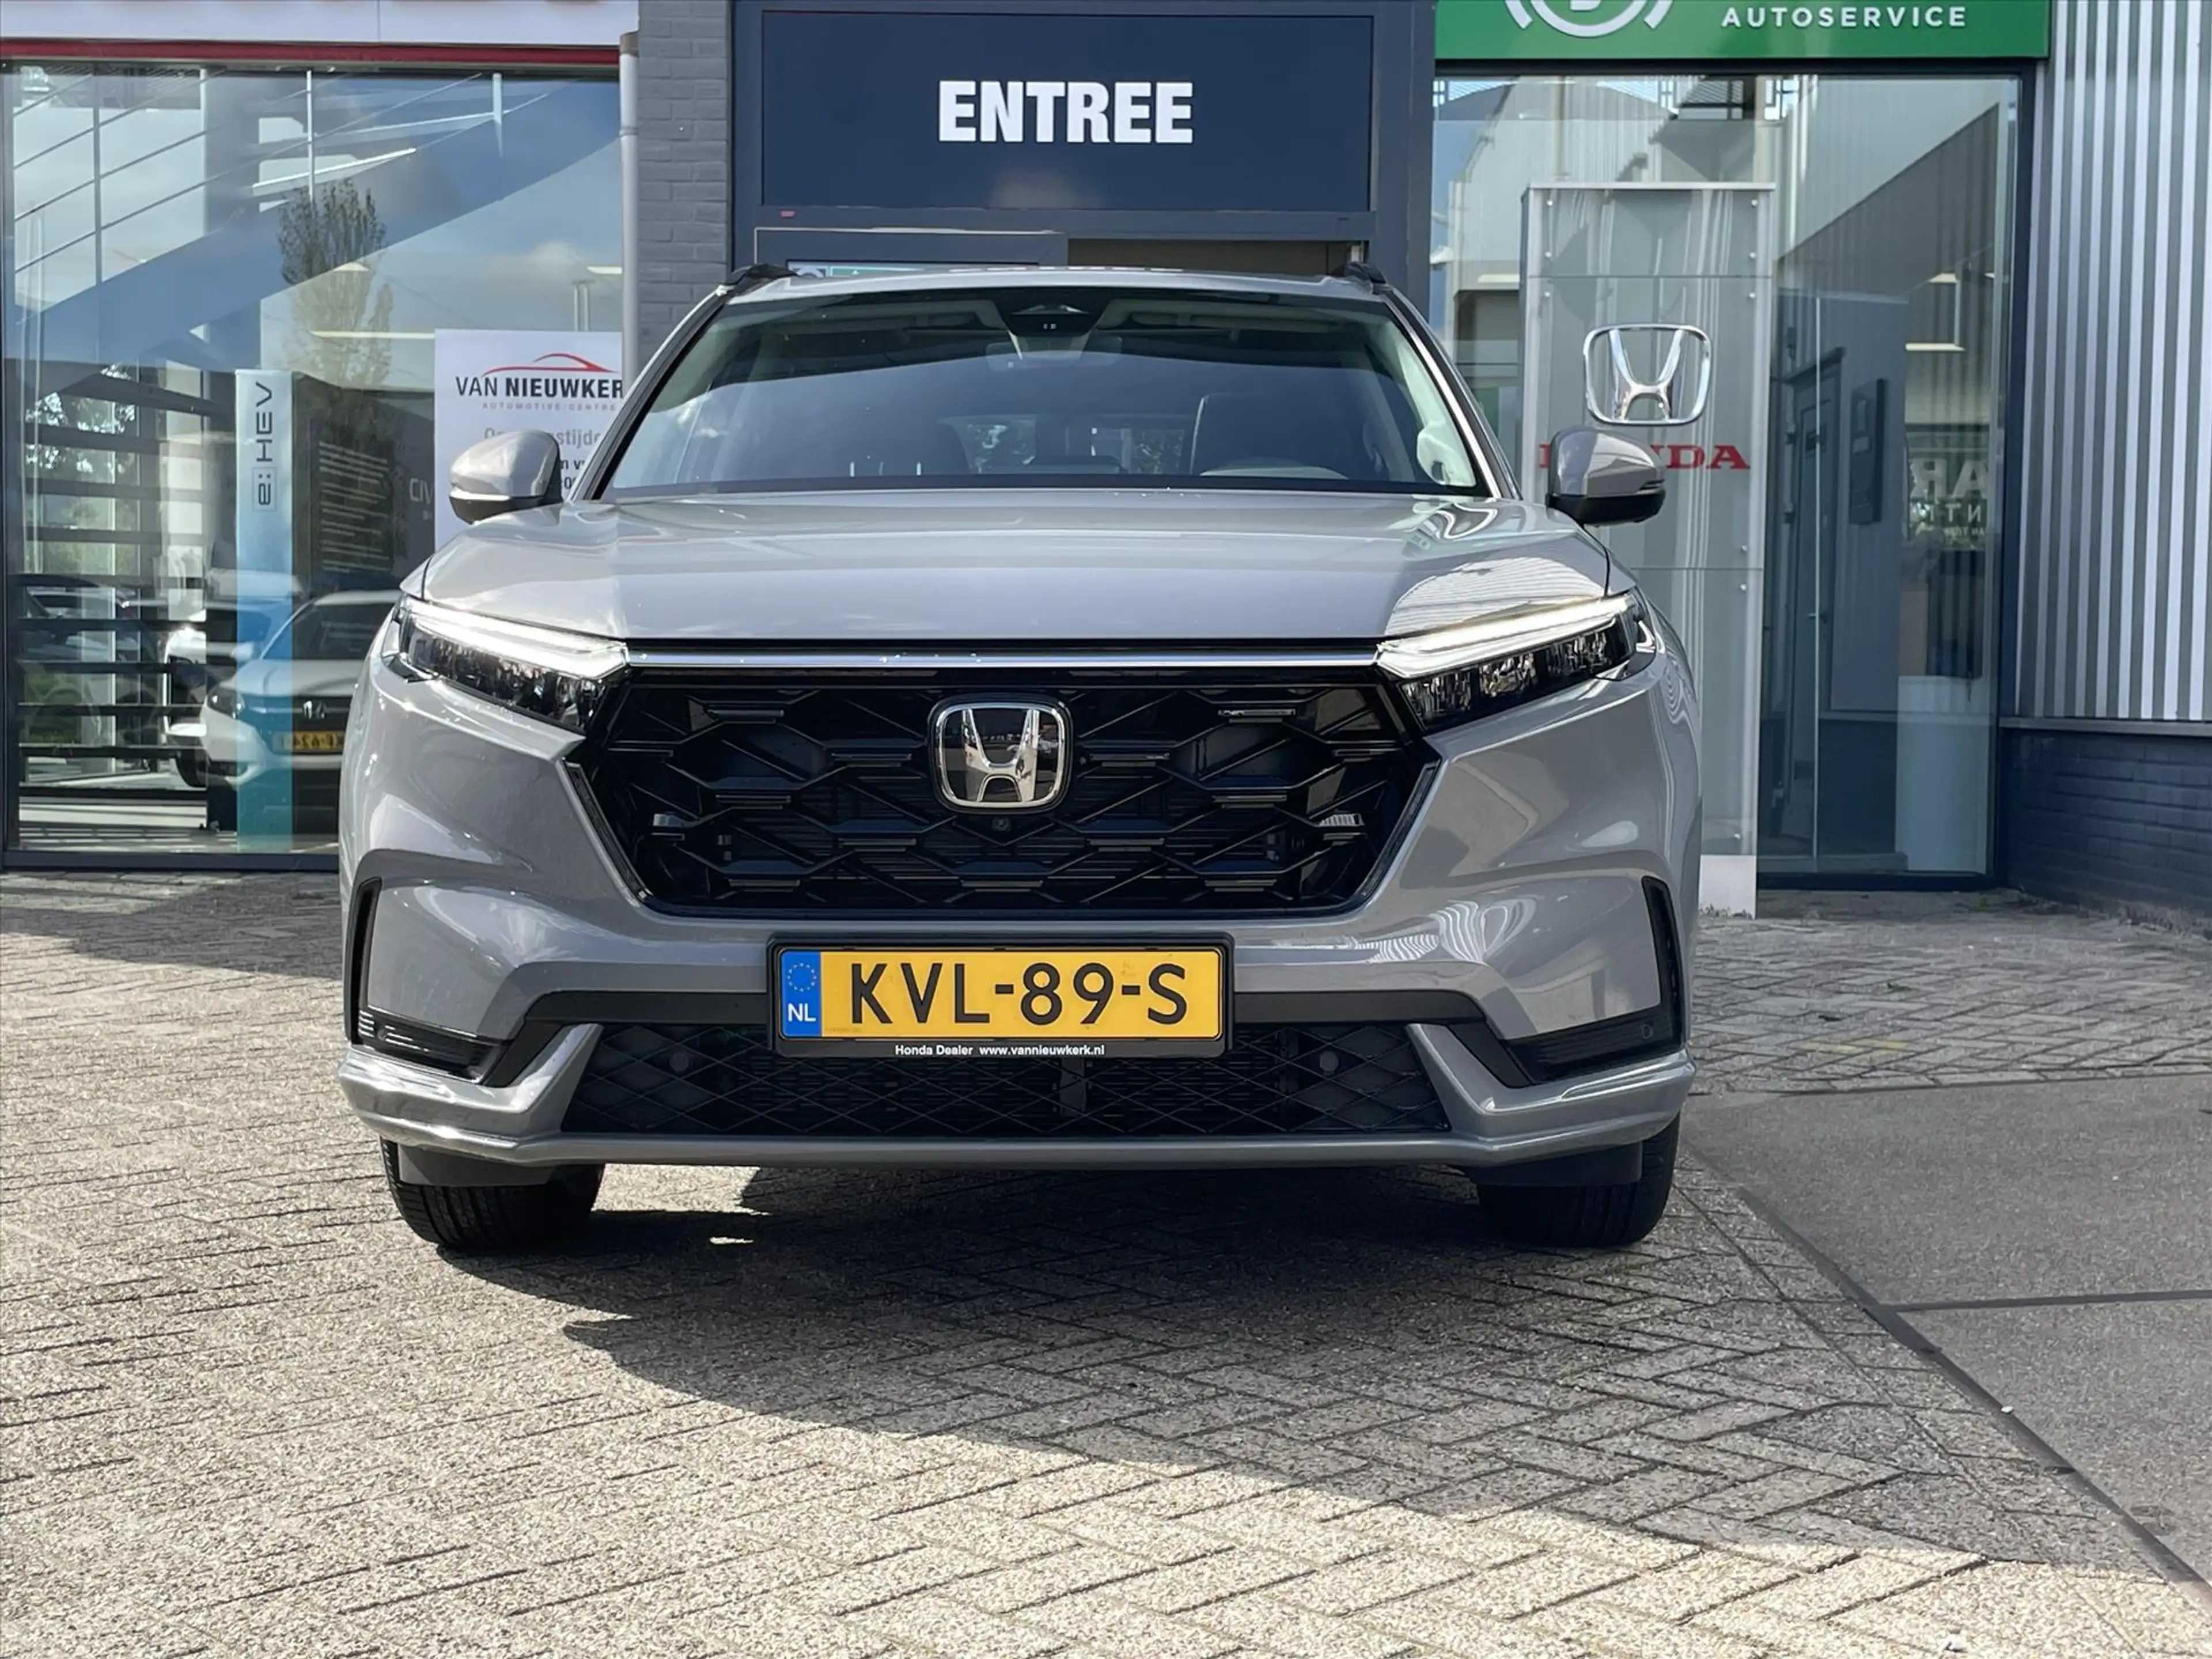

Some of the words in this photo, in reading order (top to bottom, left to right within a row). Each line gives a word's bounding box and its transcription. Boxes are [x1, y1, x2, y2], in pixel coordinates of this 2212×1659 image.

[1722, 6, 1967, 28] AUTOSERVICE
[939, 81, 1193, 143] ENTREE
[456, 377, 497, 397] VAN
[482, 402, 560, 411] AUTOMOTIVE
[851, 963, 1188, 1025] KVL-89-S
[787, 1003, 816, 1022] NL
[895, 1045, 933, 1055] Honda
[936, 1045, 973, 1055] Dealer
[979, 1045, 1105, 1055] www.vannieuwkerk.nl
